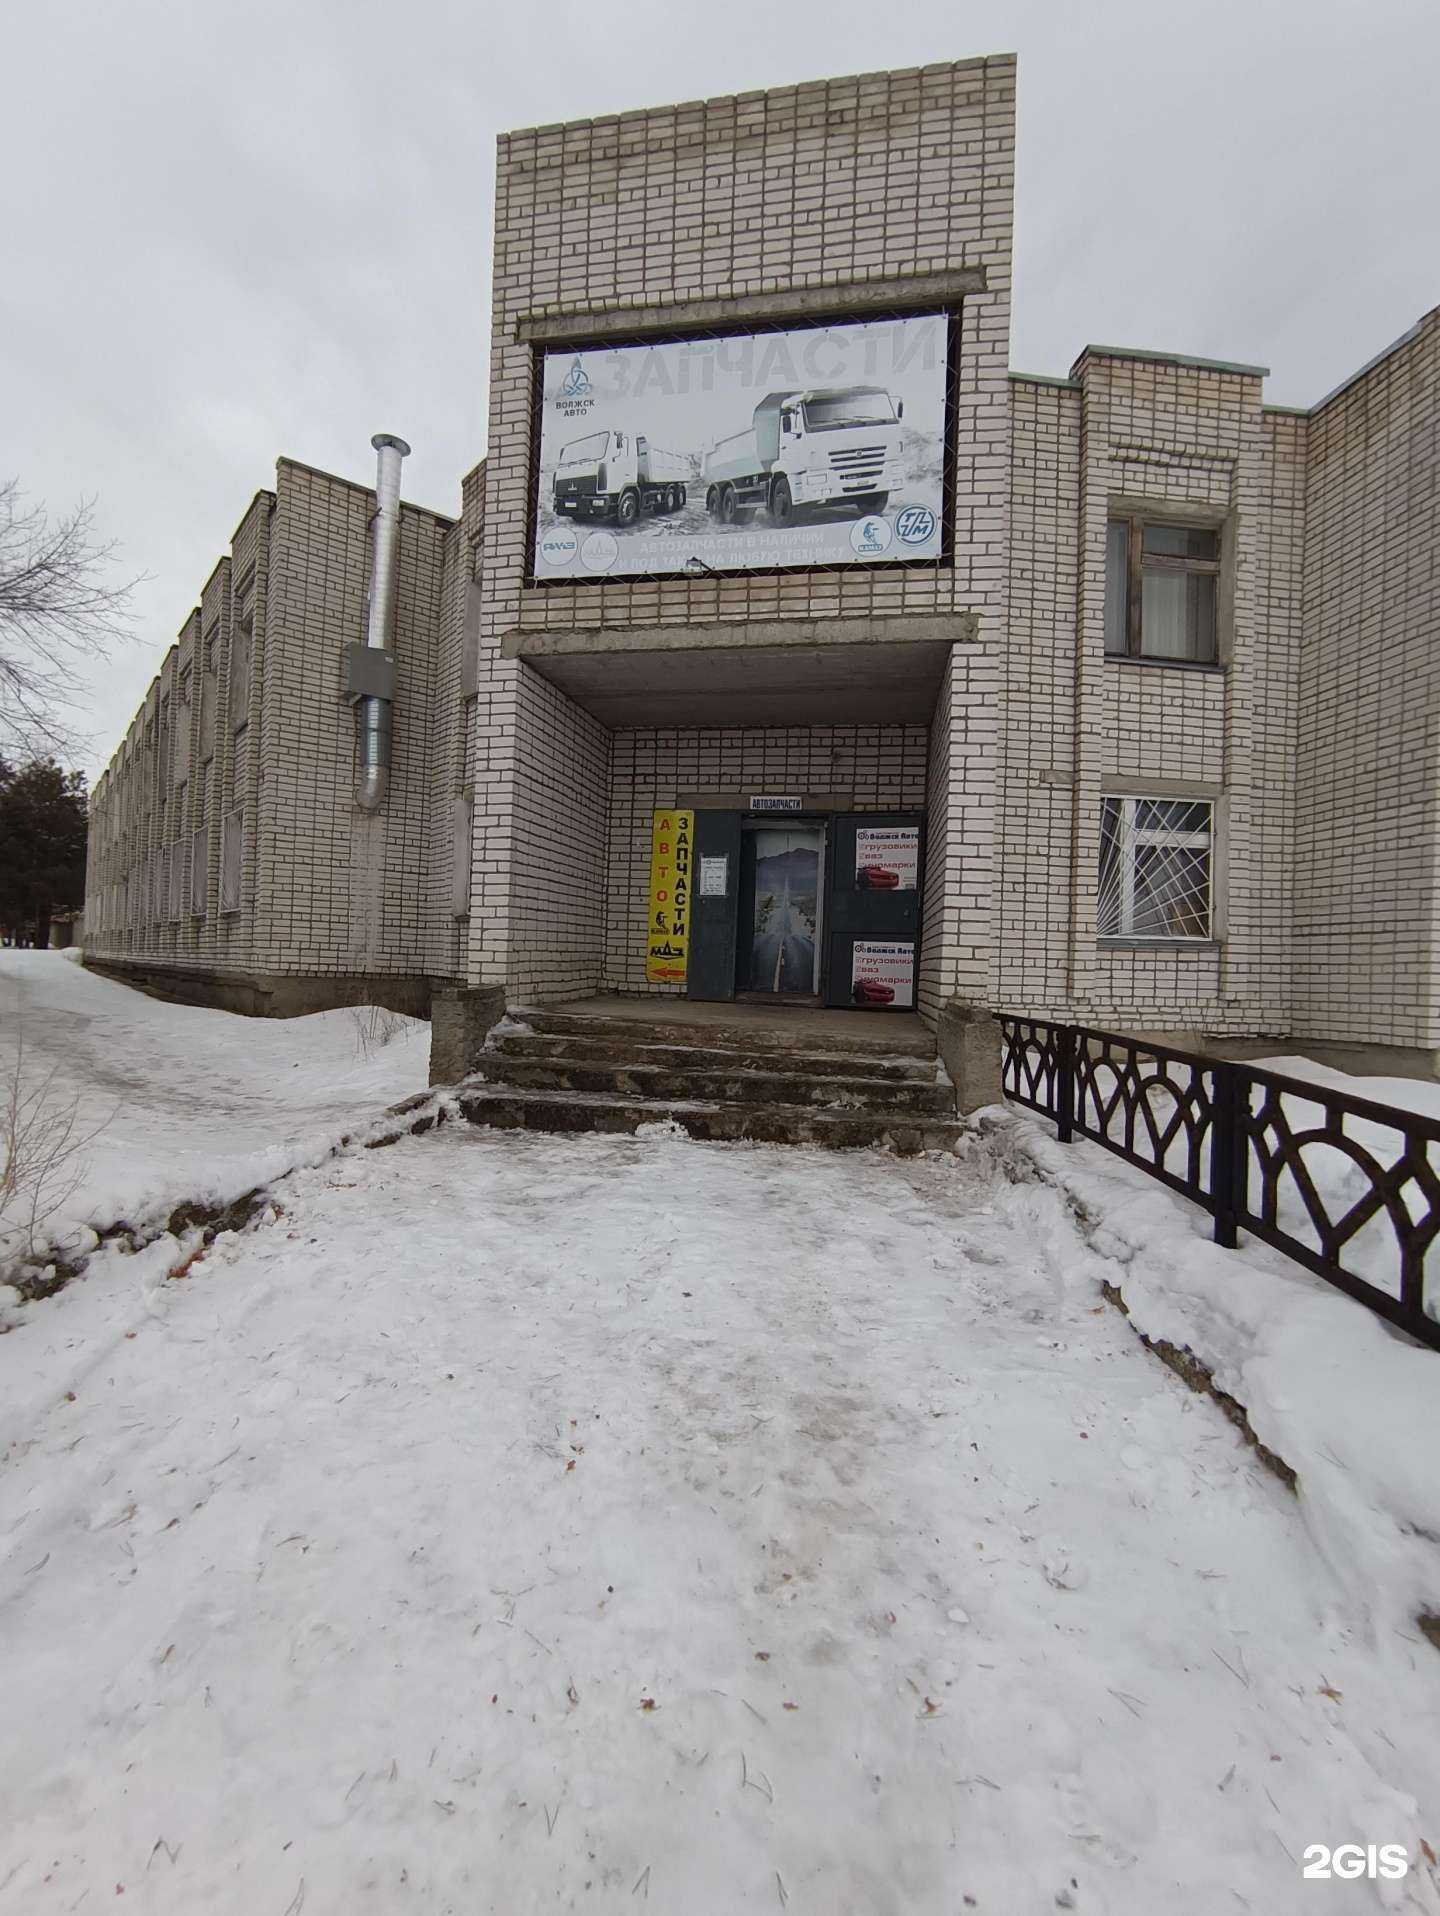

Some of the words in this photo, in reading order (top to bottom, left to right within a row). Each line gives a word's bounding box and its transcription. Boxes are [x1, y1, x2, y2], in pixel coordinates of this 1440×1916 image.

[605, 323, 937, 398] ЗАПЧАСТИ
[555, 400, 596, 410] ВОЛЖСК
[563, 408, 588, 417] АВТО
[752, 799, 801, 809] АВТОЗАПЧАСТИ
[656, 819, 671, 902] АВТО
[672, 817, 688, 936] ЗАПЧАСТИ
